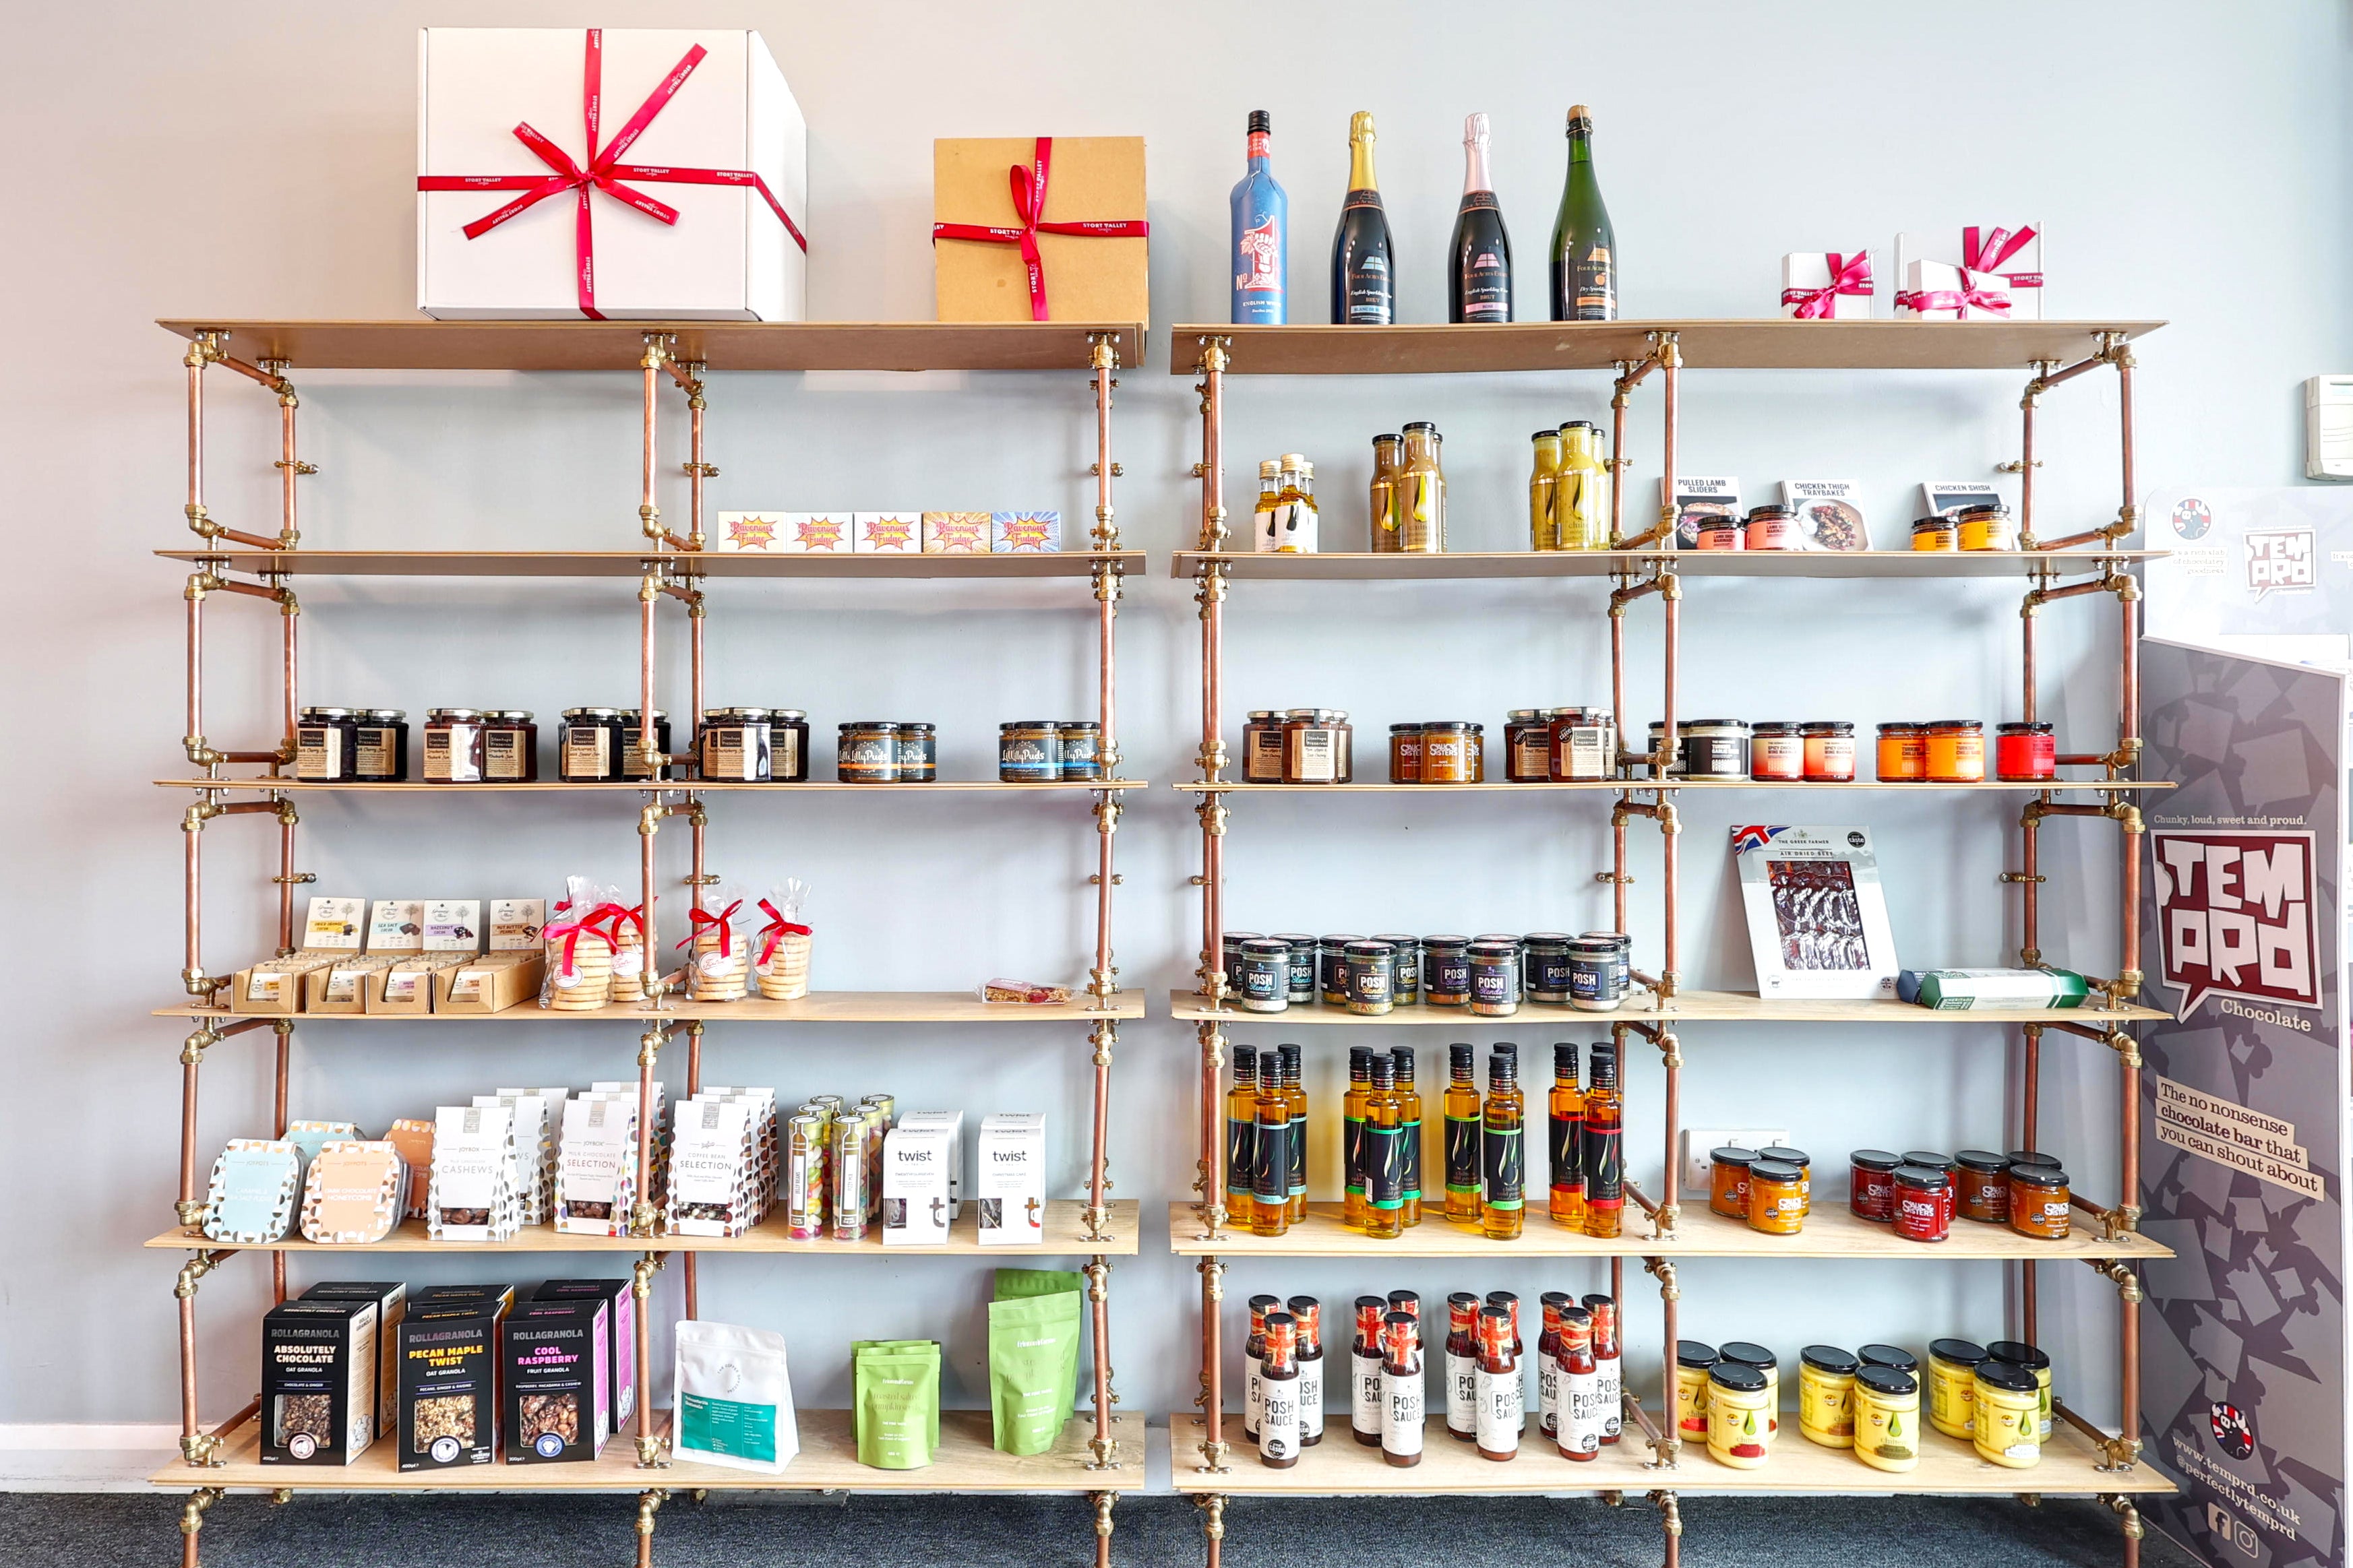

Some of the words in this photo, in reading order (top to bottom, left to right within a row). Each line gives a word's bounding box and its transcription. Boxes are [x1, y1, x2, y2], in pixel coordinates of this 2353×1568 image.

[1795, 482, 1826, 491] CHICKEN
[738, 532, 766, 544] Fudge
[805, 533, 833, 545] Fudge
[874, 533, 901, 545] Fudge
[944, 532, 971, 544] Fudge
[1012, 532, 1040, 544] Fudge
[851, 749, 889, 764] LillyPuds
[2153, 815, 2190, 825] Chunky,
[2191, 815, 2215, 825] loud,
[2217, 817, 2245, 825] sweet
[2247, 816, 2268, 825] and
[2269, 816, 2306, 826] proud.
[1291, 966, 1312, 977] POSH
[1444, 968, 1467, 978] POSH
[1548, 966, 1570, 978] POSH
[1249, 972, 1273, 986] POSH
[1360, 976, 1385, 989] POSH
[1477, 976, 1503, 990] POSH
[1572, 972, 1596, 985] POSH
[2220, 999, 2312, 1032] Chocolate
[2161, 1082, 2186, 1103] The
[2188, 1094, 2207, 1110] no
[2210, 1101, 2288, 1136] nonsense
[2161, 1104, 2230, 1139] chocolate
[2233, 1127, 2263, 1150] bar
[2266, 1139, 2301, 1163] that
[898, 1150, 933, 1162] twist
[992, 1150, 1027, 1162] twist
[2160, 1125, 2185, 1144] you
[2188, 1136, 2214, 1154] can
[2218, 1146, 2264, 1172] shout
[2267, 1164, 2318, 1191] about
[442, 1165, 493, 1174] CASHEWS
[567, 1159, 616, 1168] SELECTION
[679, 1160, 732, 1170] SELECTION
[271, 1329, 340, 1339] ROLLAGRANOLA
[409, 1329, 483, 1344] ROLLAGRANOLA
[513, 1329, 584, 1341] ROLLAGRANOLA
[274, 1346, 336, 1354] ABSOLUTELY
[408, 1348, 444, 1359] PECAN
[448, 1345, 484, 1356] MAPLE
[534, 1346, 562, 1356] COOL
[276, 1354, 334, 1364] CHOCOLATE
[429, 1356, 464, 1367] TWIST
[518, 1354, 579, 1366] RASPBERRY
[1365, 1377, 1381, 1391] PO
[1459, 1375, 1475, 1390] PO
[1541, 1385, 1556, 1400] SAU
[1264, 1398, 1294, 1414] POSH
[1393, 1395, 1421, 1410] POSH
[1264, 1411, 1294, 1426] SAUCE
[1393, 1408, 1421, 1422] SAUCE
[2173, 1436, 2301, 1526] www.temprd.co.uk
[2176, 1454, 2296, 1542] @perfectlytemprd
